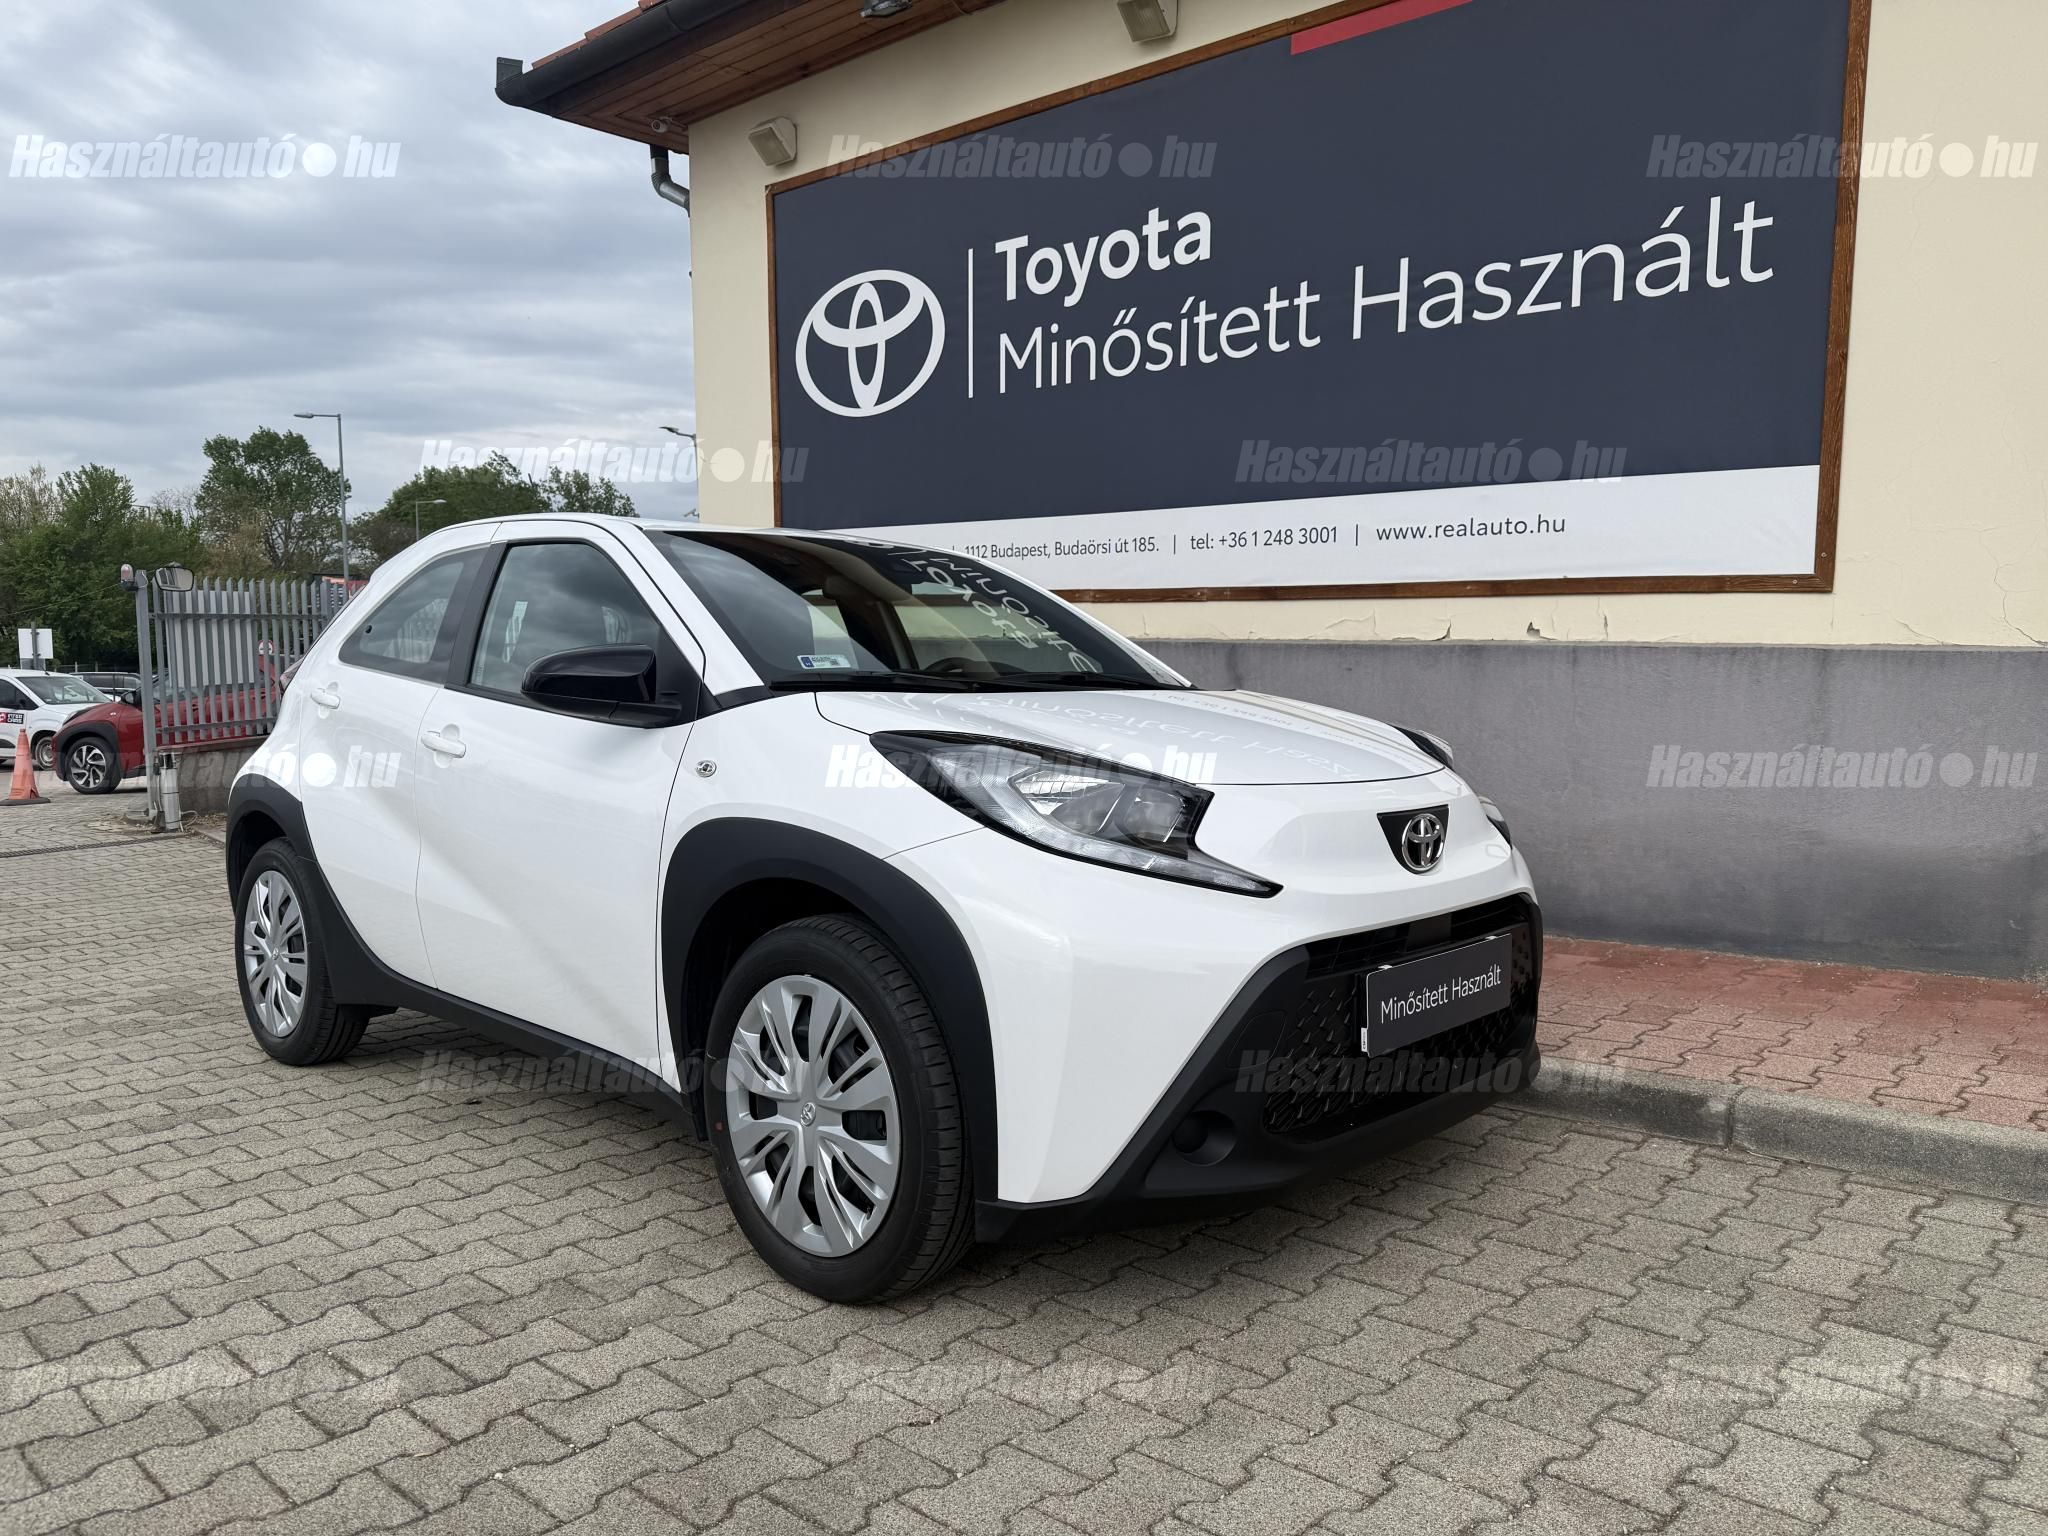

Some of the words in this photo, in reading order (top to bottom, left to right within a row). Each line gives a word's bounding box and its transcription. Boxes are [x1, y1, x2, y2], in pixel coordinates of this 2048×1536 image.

[995, 207, 1211, 307] Toyota
[1000, 280, 1320, 393] Minősített
[1352, 196, 1774, 340] Használt
[991, 542, 1051, 561] Budapest,
[1055, 538, 1111, 556] Budaörsi
[1115, 537, 1129, 553] út
[1132, 536, 1160, 552] 185.
[1190, 533, 1215, 550] tel:
[1218, 531, 1248, 548] +36
[1263, 528, 1294, 547] 248
[1298, 526, 1338, 545] 3001
[1376, 513, 1566, 541] www.realauto.hu
[1381, 983, 1449, 1024] Minősített
[1452, 963, 1502, 1000] Használt
